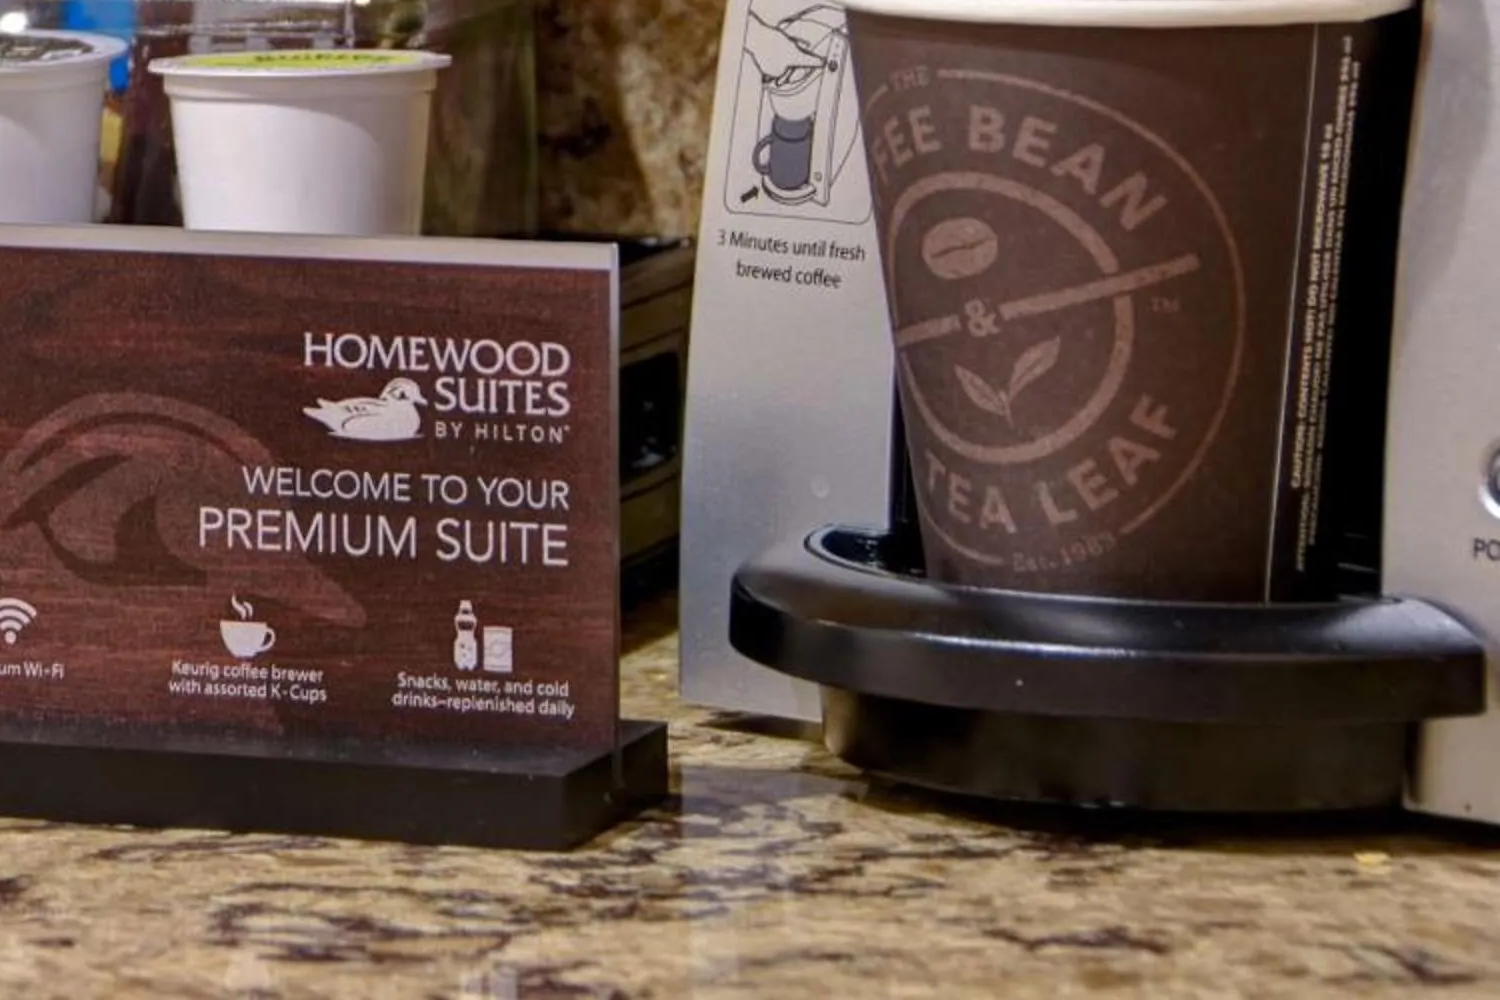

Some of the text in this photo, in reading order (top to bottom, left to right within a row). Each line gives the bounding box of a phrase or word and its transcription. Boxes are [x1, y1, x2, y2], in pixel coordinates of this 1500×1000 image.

[890, 66, 930, 92] THE
[969, 104, 1168, 232] BEAN
[716, 229, 866, 262] 3 Minutes until fresh
[736, 259, 842, 289] brewed coffee
[964, 299, 1000, 337] &
[303, 332, 570, 377] HOMEWOOD
[434, 377, 571, 417] SUITES
[435, 421, 564, 443] BY HILTON
[925, 394, 1178, 534] TEA LEAF
[242, 465, 570, 511] WELCOME TO YOUR
[199, 506, 569, 567] PREMIUM SUITE
[171, 659, 324, 683] Keurig coffee brewer
[397, 671, 569, 698] Snacks, water, and cold
[168, 678, 201, 695] with
[203, 681, 267, 698] assorted
[537, 700, 576, 721] daily
